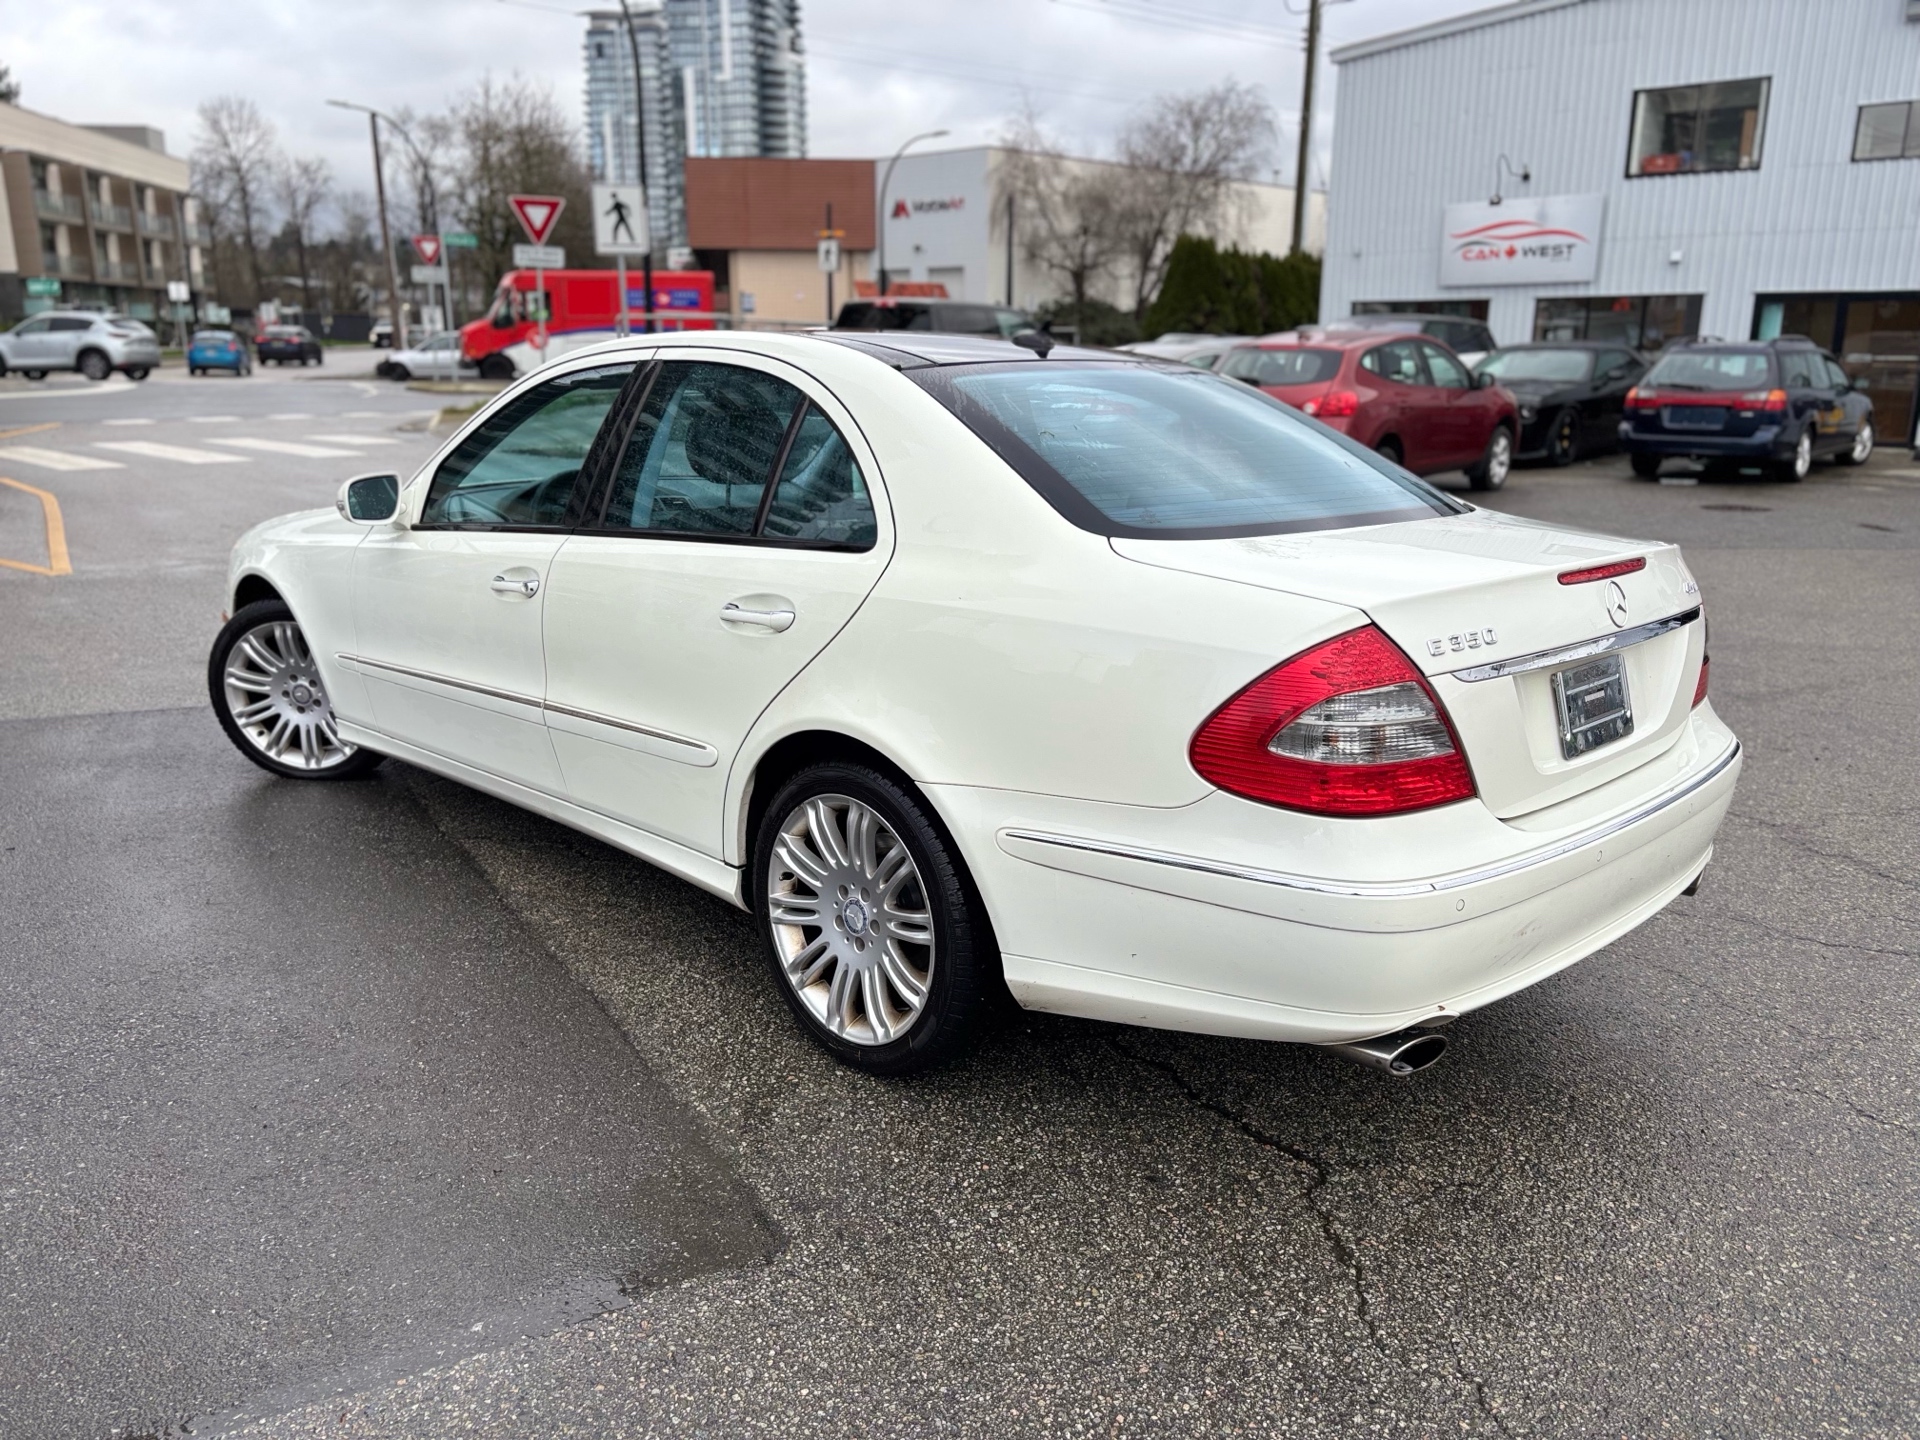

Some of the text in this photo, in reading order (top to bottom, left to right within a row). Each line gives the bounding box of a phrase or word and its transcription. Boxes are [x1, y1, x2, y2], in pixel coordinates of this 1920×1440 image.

[1461, 243, 1577, 261] CAN WEST
[1426, 628, 1498, 657] E 350
